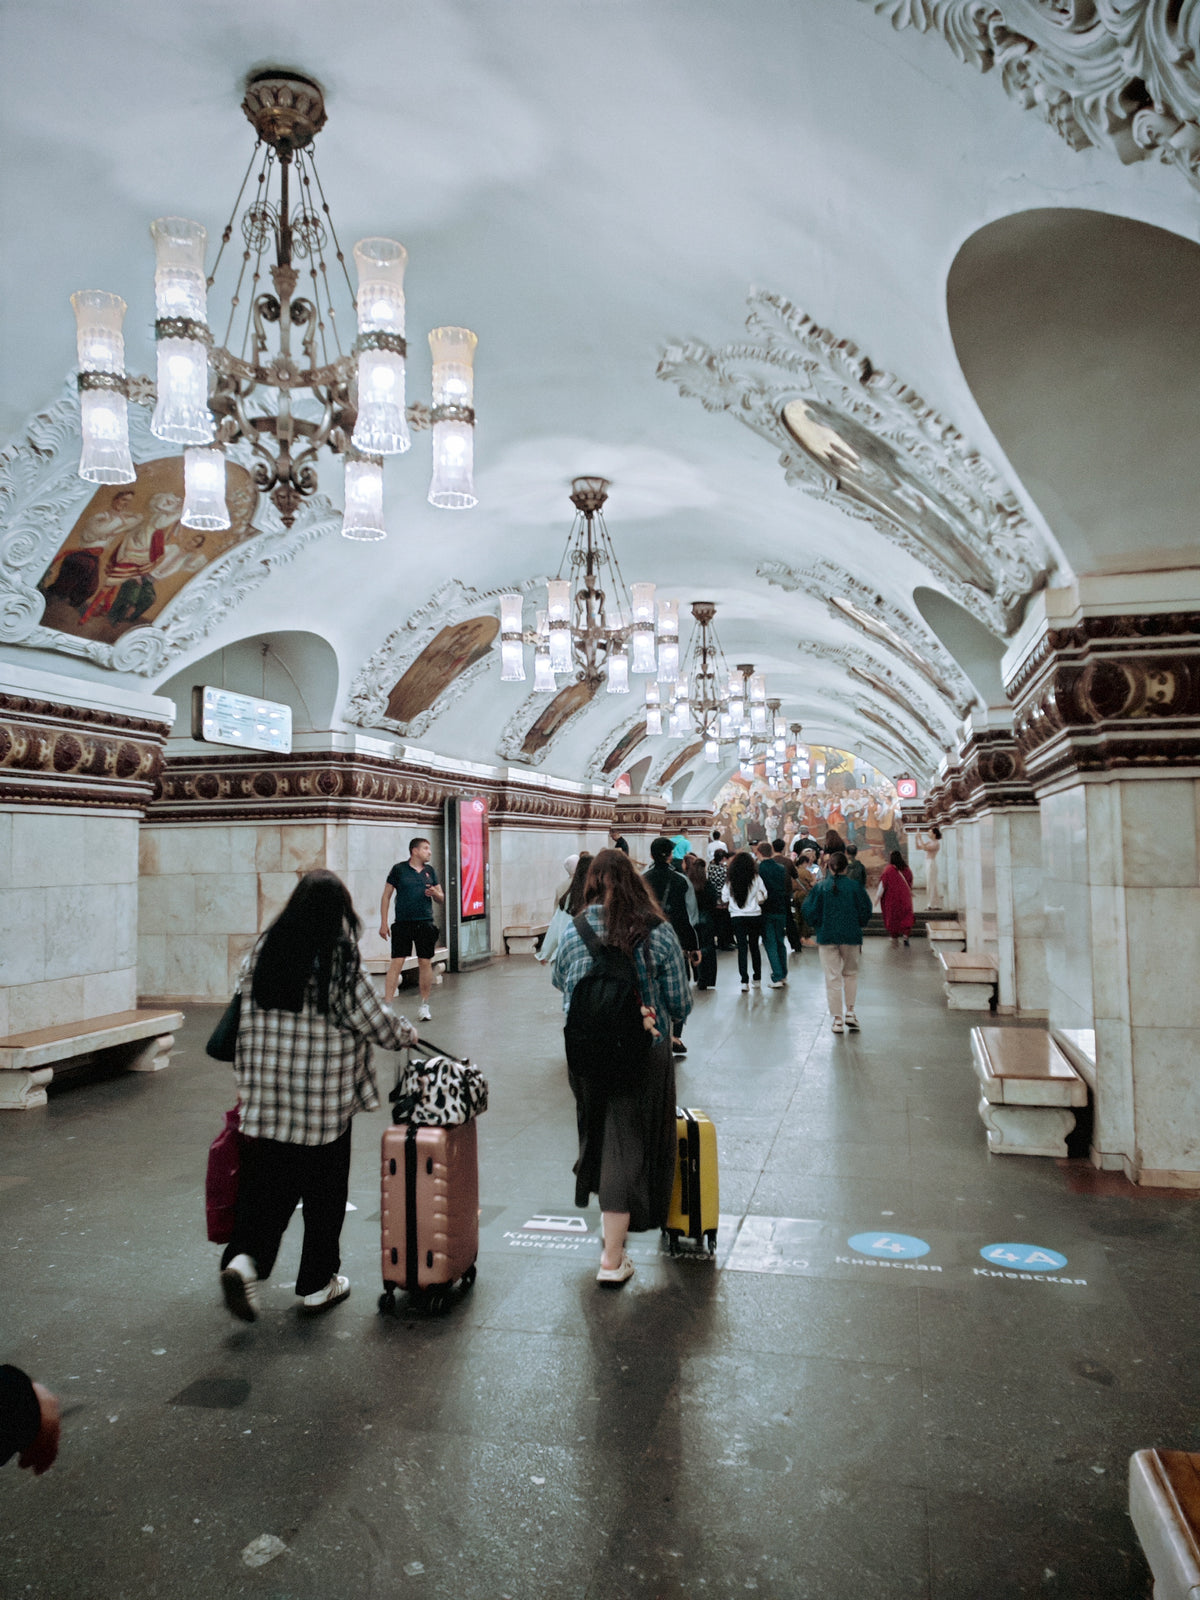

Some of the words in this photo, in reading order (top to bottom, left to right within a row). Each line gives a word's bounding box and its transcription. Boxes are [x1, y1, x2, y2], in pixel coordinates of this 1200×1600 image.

[509, 1240, 580, 1250] вокзал
[871, 1237, 906, 1253] 4
[835, 1256, 943, 1272] Киевская
[973, 1268, 1088, 1286] Киевская
